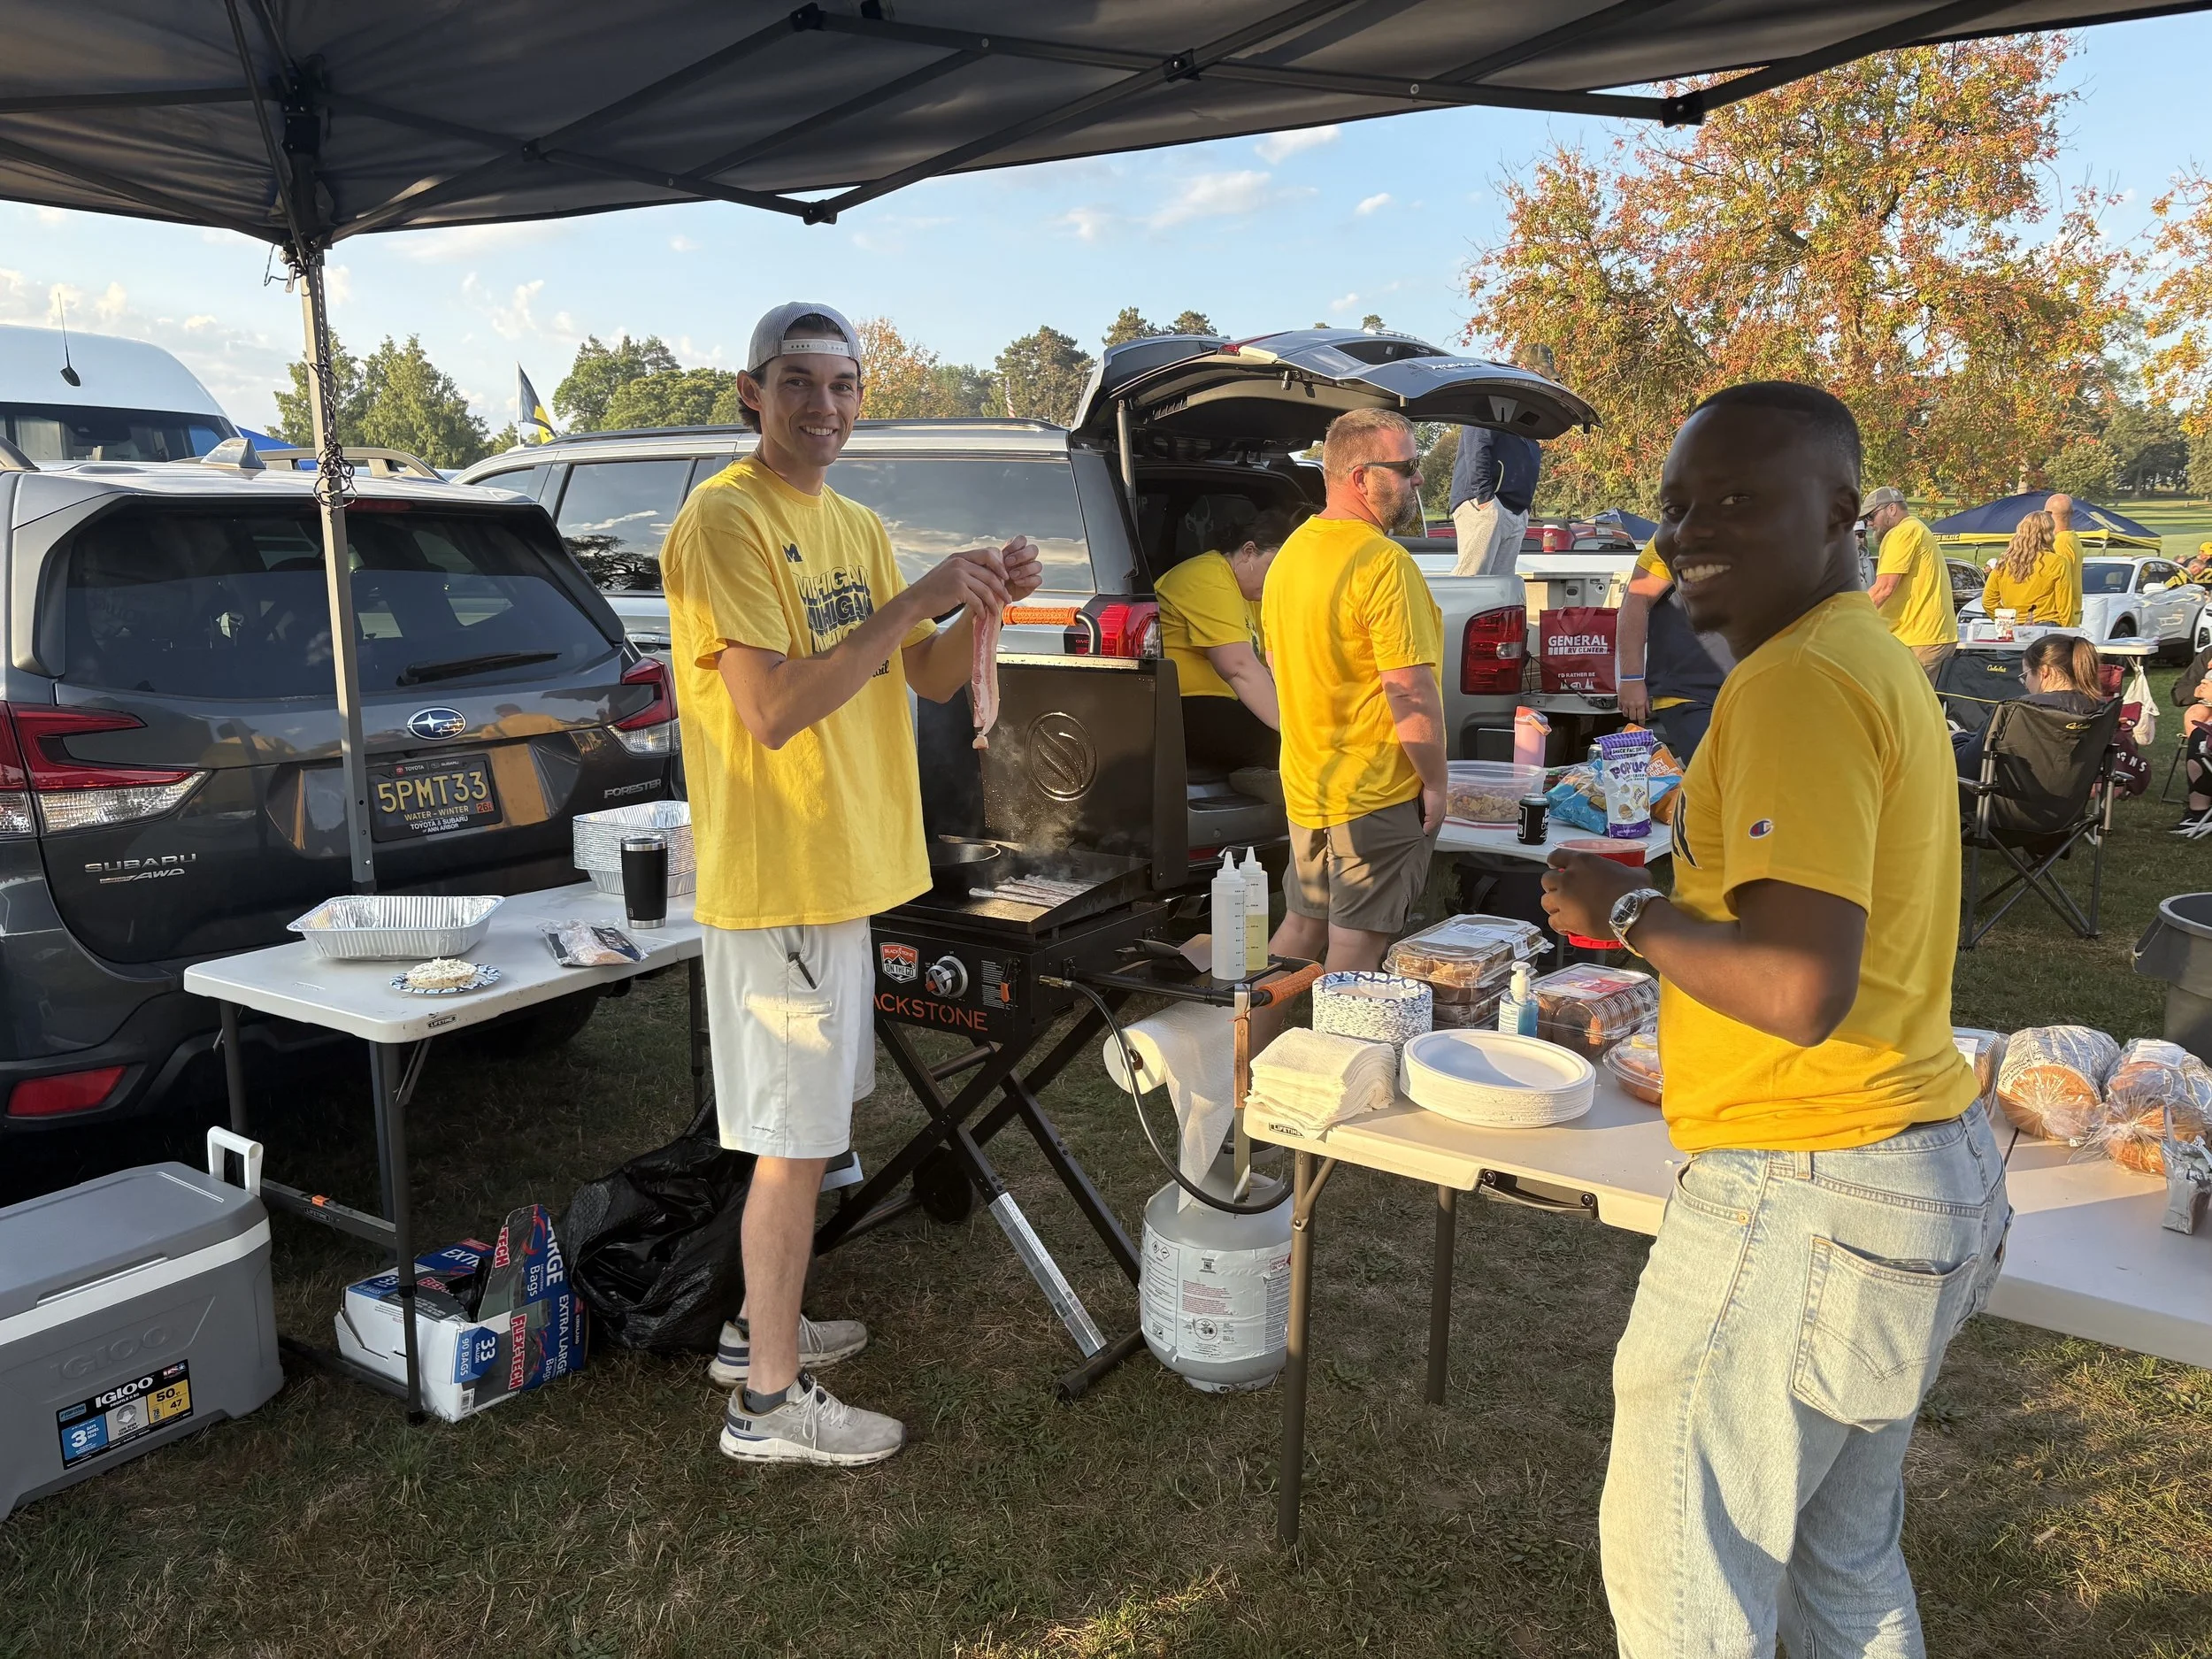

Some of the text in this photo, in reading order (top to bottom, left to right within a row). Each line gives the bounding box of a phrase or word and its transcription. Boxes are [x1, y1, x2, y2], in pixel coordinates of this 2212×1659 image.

[1548, 635, 1608, 647] GENERAL
[377, 772, 488, 813] 5PMT33
[604, 779, 662, 799] FORESTER
[403, 810, 432, 821] WATER
[438, 805, 470, 817] WINTER
[410, 820, 437, 830] TOYOTA
[442, 816, 469, 826] SUBARU
[85, 853, 196, 873] SUBARU
[132, 868, 186, 880] AWD
[886, 964, 914, 977] ON THE GO
[429, 1017, 456, 1027] LIFETIME
[873, 993, 988, 1032] ACKSTONE
[527, 1264, 540, 1297] Bags
[557, 1294, 569, 1376] EXTRA LARGE
[460, 1338, 470, 1376] 90 BAGS
[480, 1336, 495, 1362] 33
[509, 1313, 526, 1390] FLEX-TECH
[95, 1377, 154, 1408] IGLOO
[110, 1396, 130, 1408] PROFILE
[156, 1387, 176, 1402] 50
[170, 1399, 183, 1409] 47
[71, 1429, 88, 1448] 3
